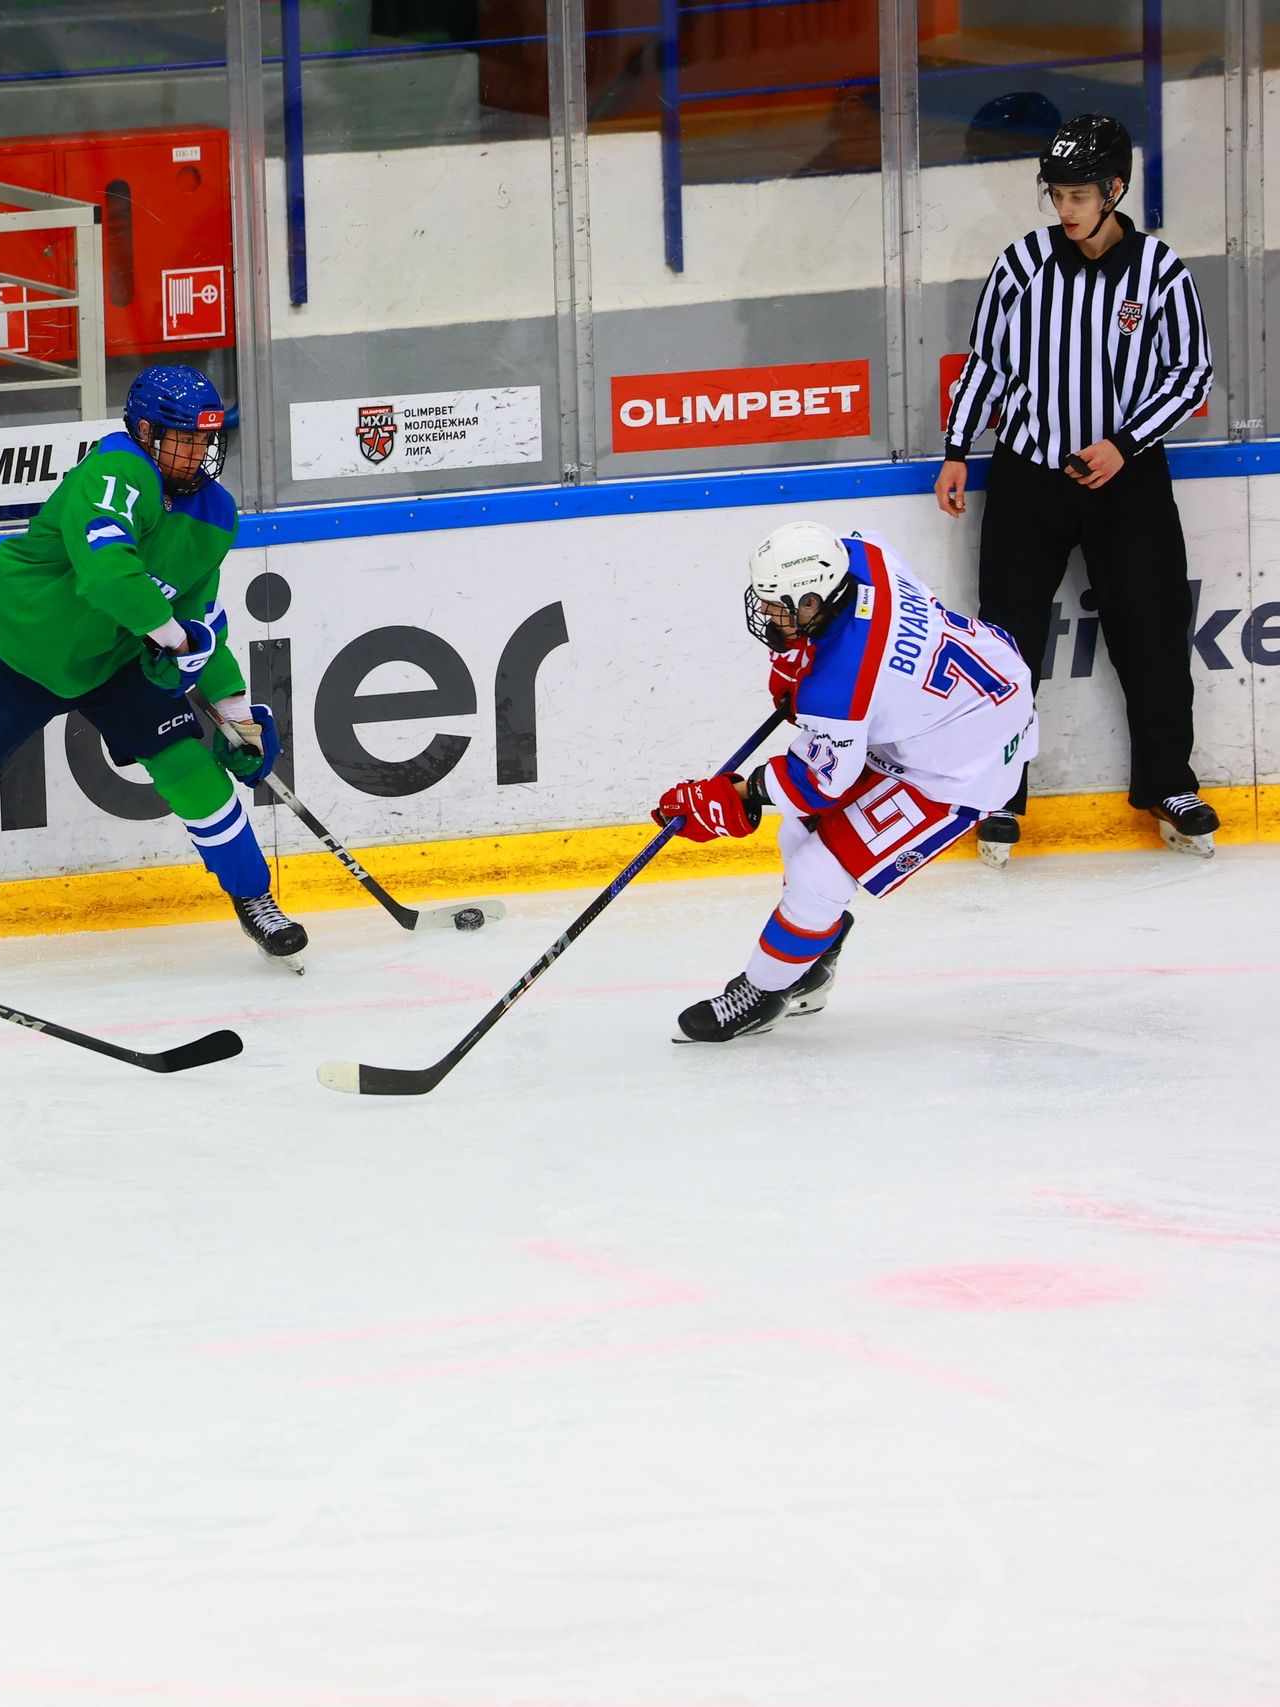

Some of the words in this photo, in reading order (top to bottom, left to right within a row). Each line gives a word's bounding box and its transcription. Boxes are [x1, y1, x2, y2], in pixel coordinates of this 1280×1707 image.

[1052, 140, 1077, 158] 67
[404, 406, 454, 418] OLIMPBET
[619, 385, 860, 428] OLIMPBET
[360, 415, 392, 427] МХЛ
[404, 417, 479, 431] МОЛОДЕЖНАЯ
[404, 430, 466, 443] ХОККЕЙНАЯ
[405, 446, 432, 456] ЛИГА
[793, 578, 817, 588] CCM
[158, 713, 195, 735] CCM
[322, 834, 369, 881] CCM
